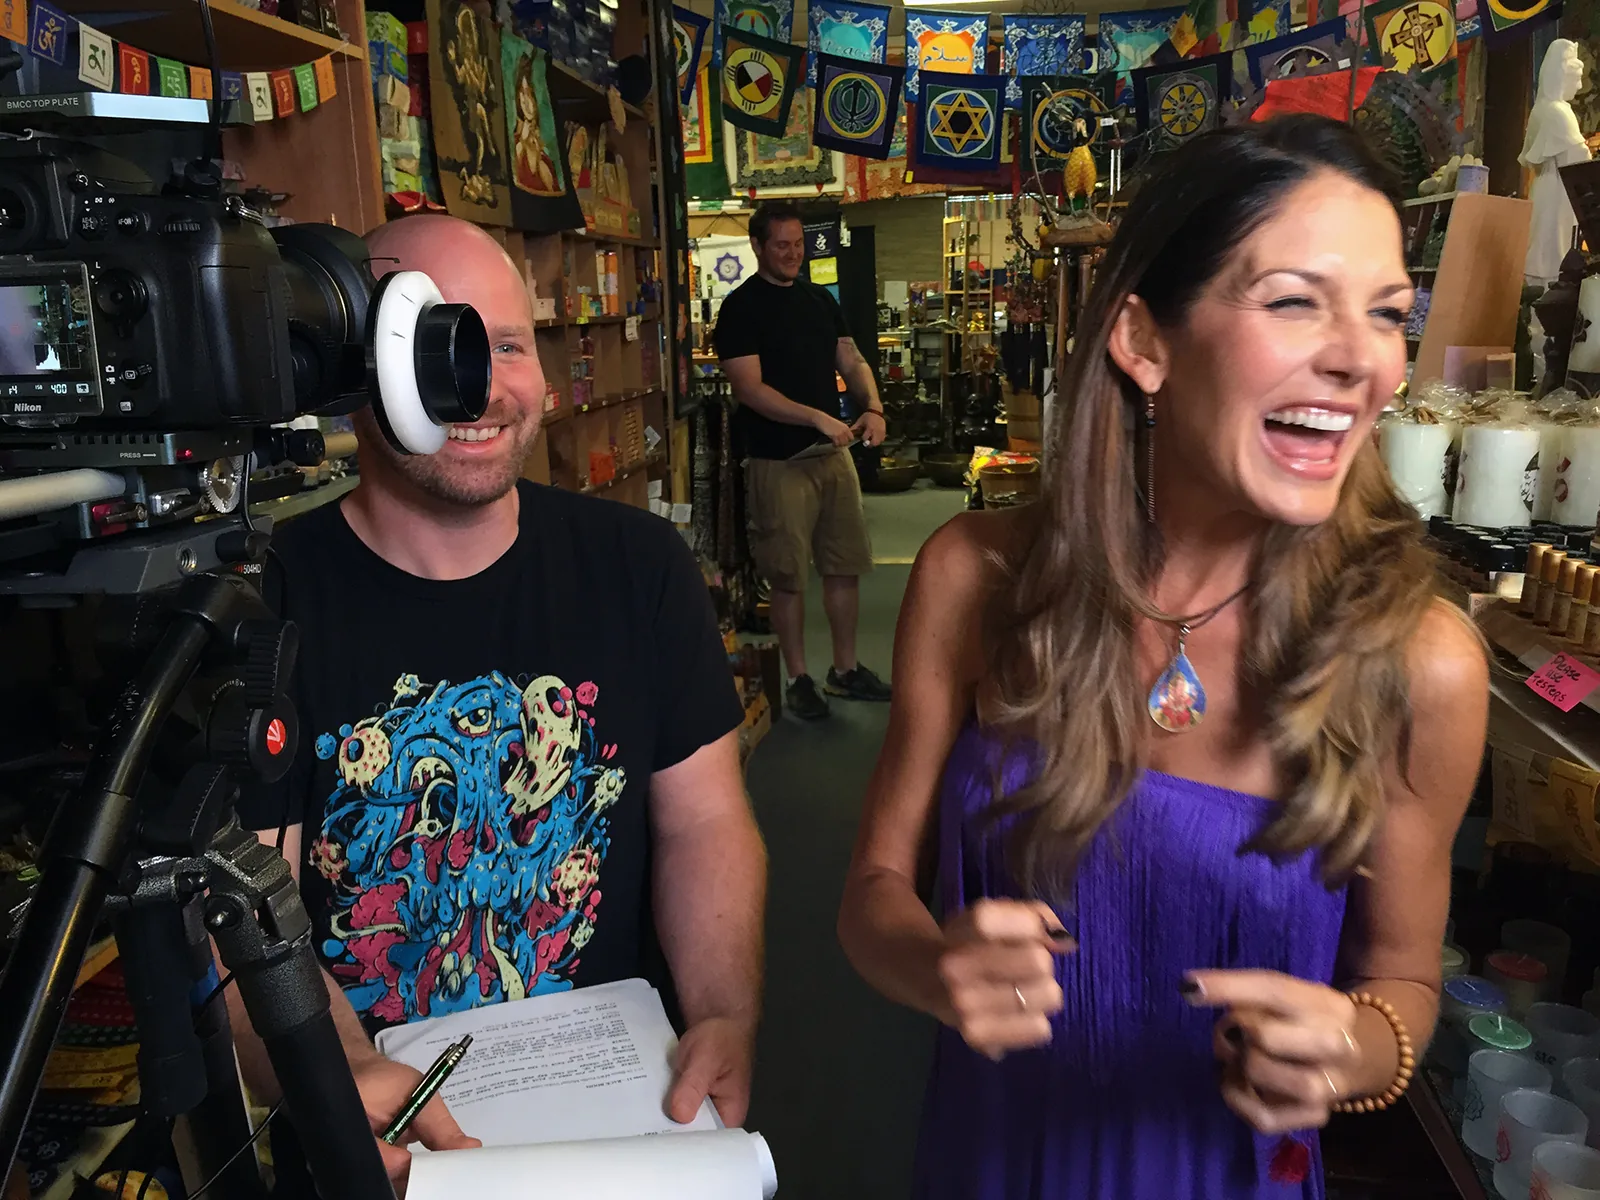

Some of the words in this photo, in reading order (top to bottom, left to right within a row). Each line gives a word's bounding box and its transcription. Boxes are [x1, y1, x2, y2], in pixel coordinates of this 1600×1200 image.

[6, 100, 32, 109] BMCC
[32, 99, 50, 107] TOP
[52, 97, 79, 106] PLATE
[50, 383, 68, 394] 400
[14, 403, 42, 412] Nikon
[243, 563, 262, 575] 504HD
